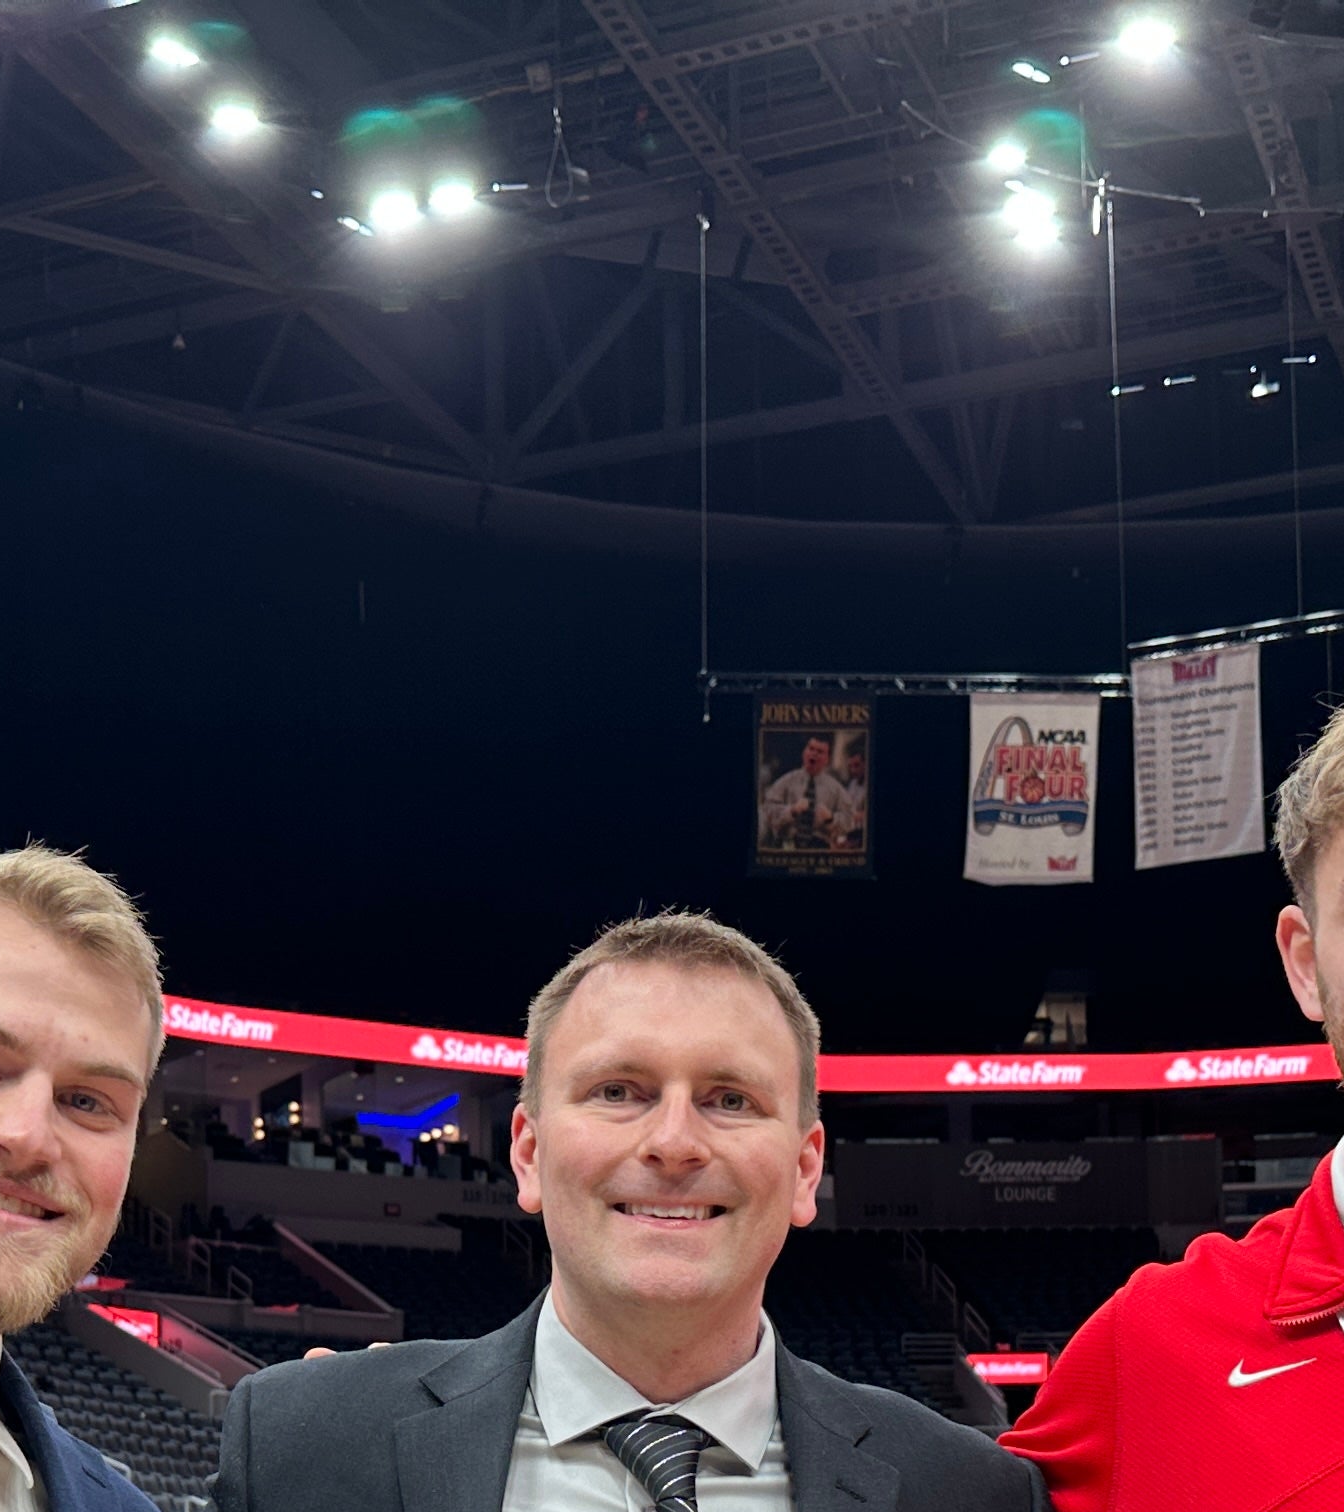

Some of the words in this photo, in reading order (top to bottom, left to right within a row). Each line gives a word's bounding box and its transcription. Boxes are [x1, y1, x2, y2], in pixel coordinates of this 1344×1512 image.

[760, 703, 800, 724] JOHN
[801, 703, 871, 724] SANDERS
[1037, 729, 1086, 745] NCAA
[994, 744, 1086, 776] FINAL
[994, 1186, 1058, 1202] LOUNGE
